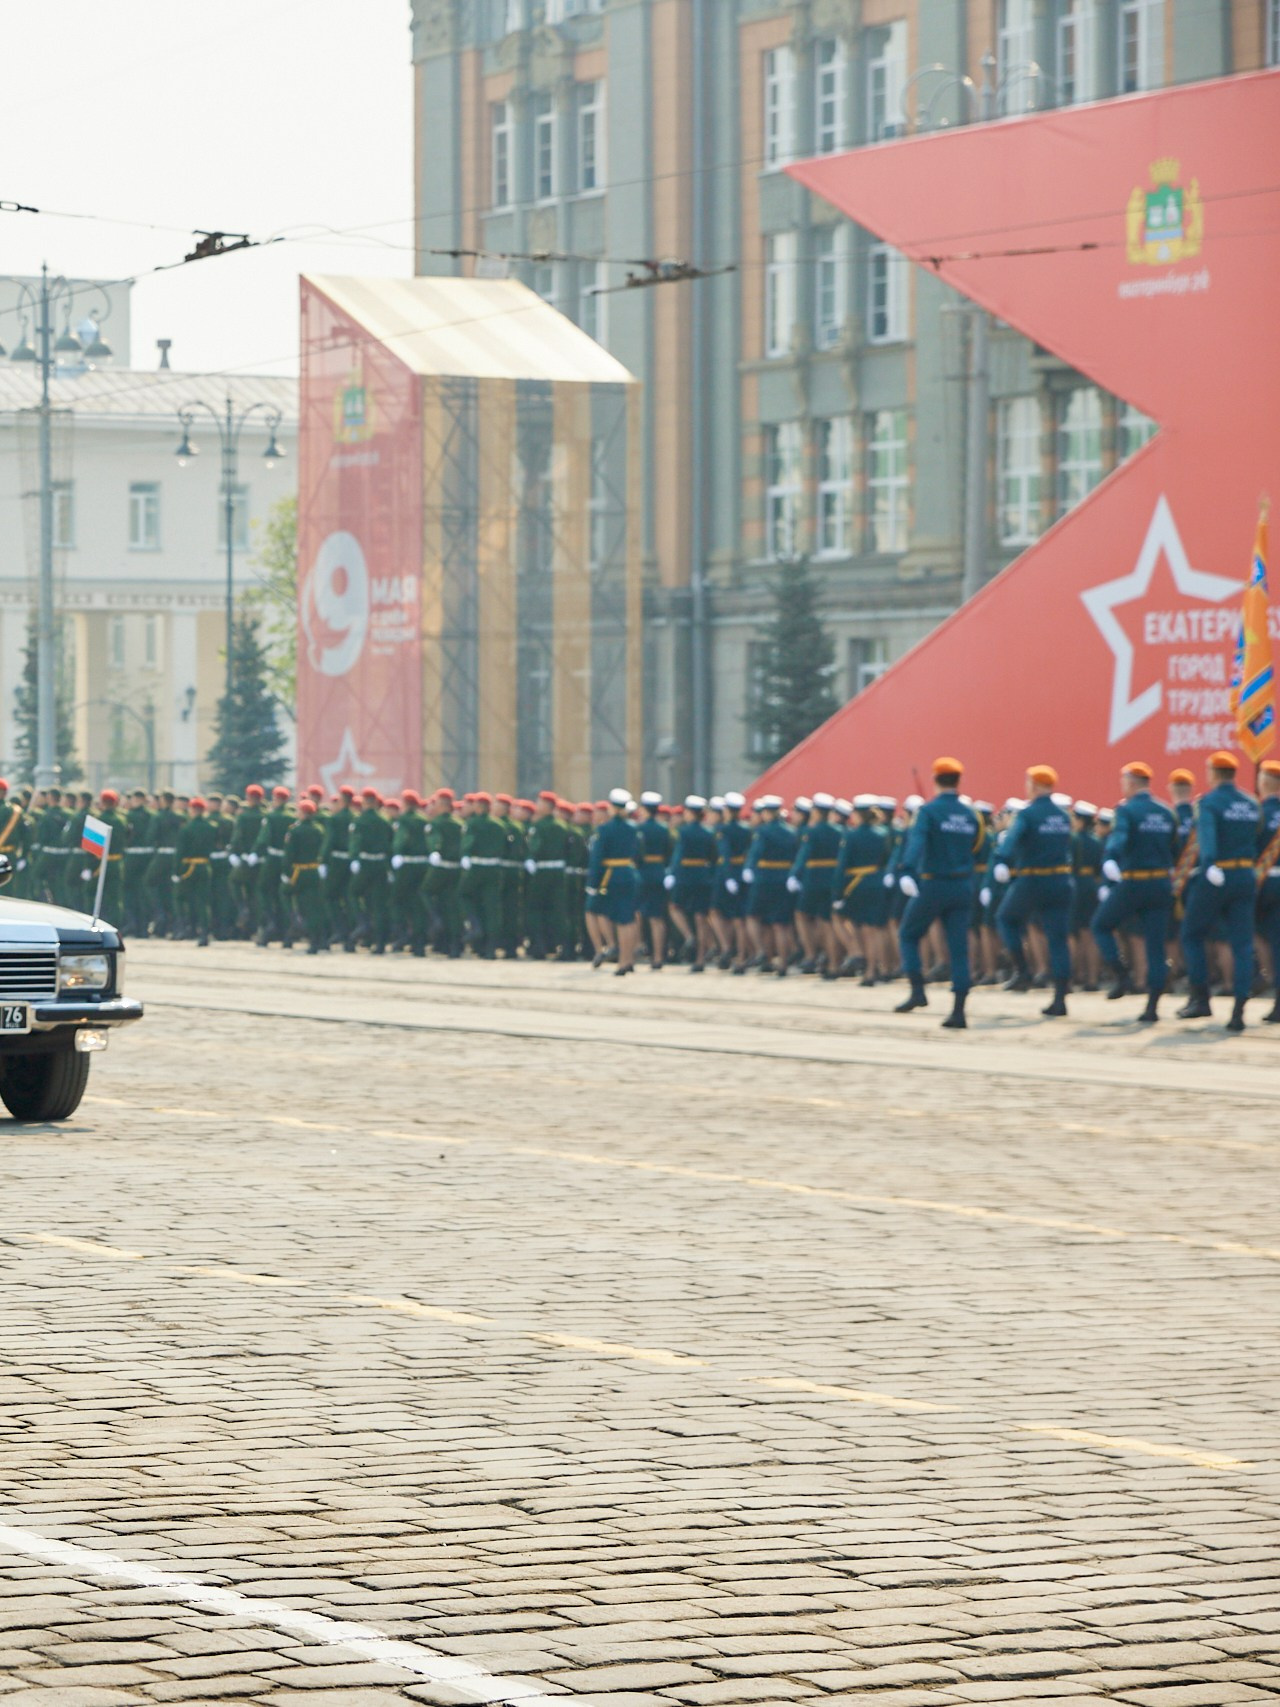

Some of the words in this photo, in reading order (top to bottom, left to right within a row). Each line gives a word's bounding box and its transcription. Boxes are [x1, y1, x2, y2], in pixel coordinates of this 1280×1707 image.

[371, 575, 417, 603] МАЯ
[1168, 653, 1225, 684] ГОРОД
[4, 1006, 23, 1023] 76
